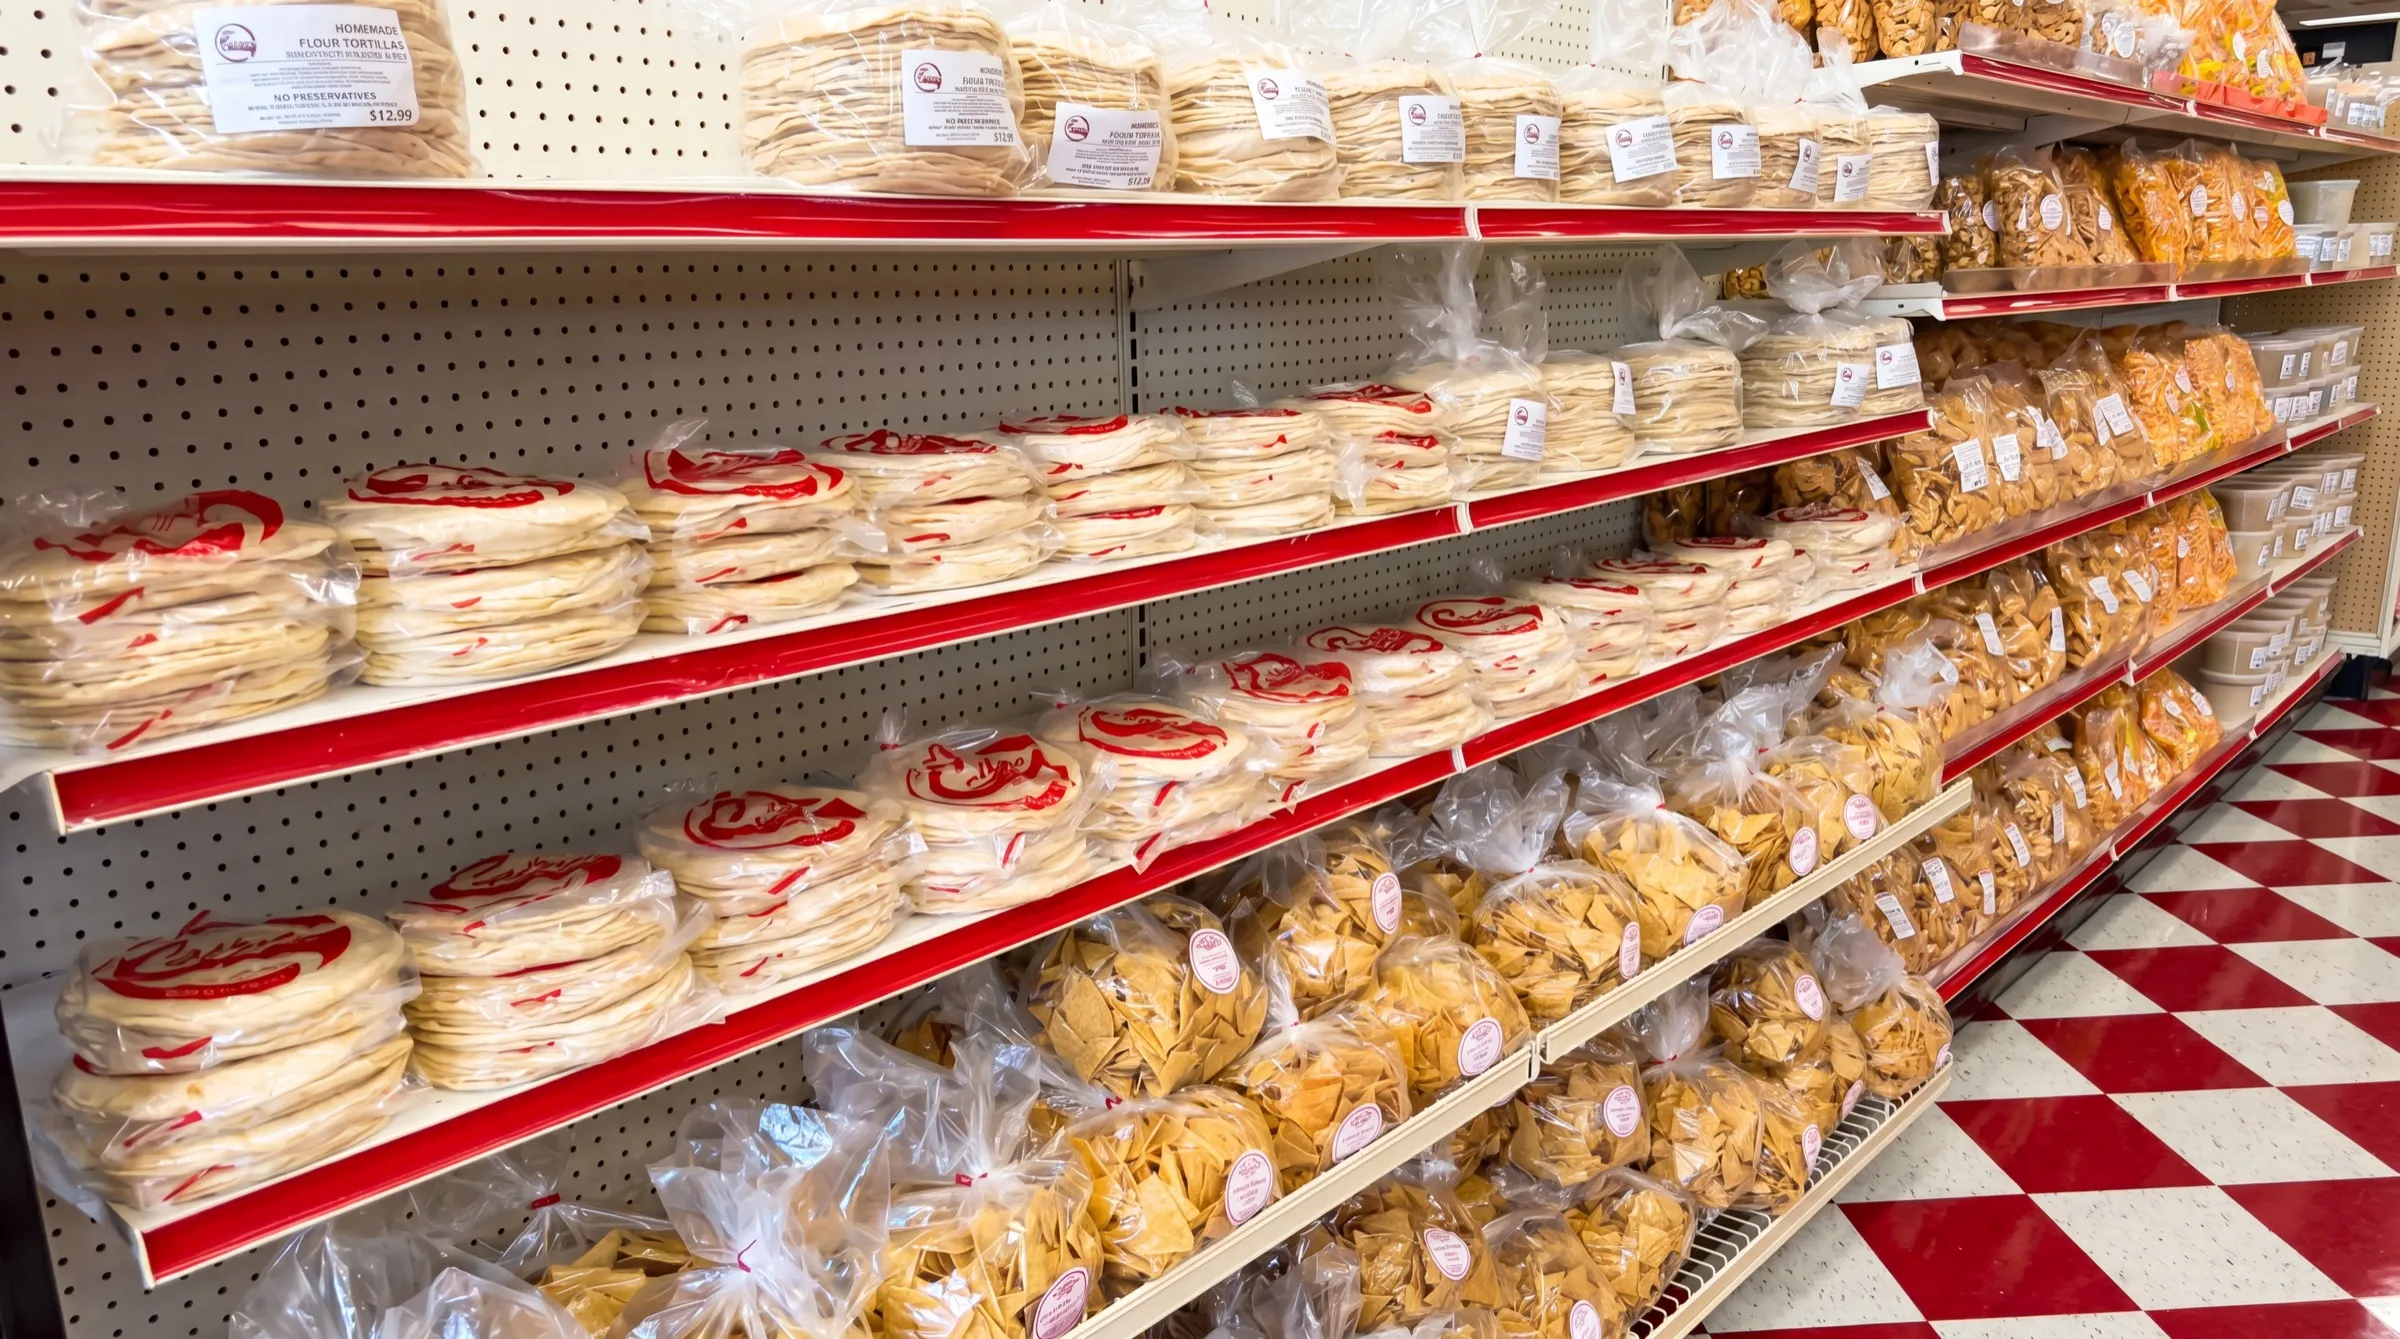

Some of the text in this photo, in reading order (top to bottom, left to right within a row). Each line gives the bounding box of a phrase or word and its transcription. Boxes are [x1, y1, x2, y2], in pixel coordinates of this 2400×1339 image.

[335, 23, 398, 36] HOMEMADE
[299, 38, 405, 50] FLOUR TORTILLAS
[273, 91, 377, 102] NO PRESERVATIVES
[369, 109, 412, 122] $12.99
